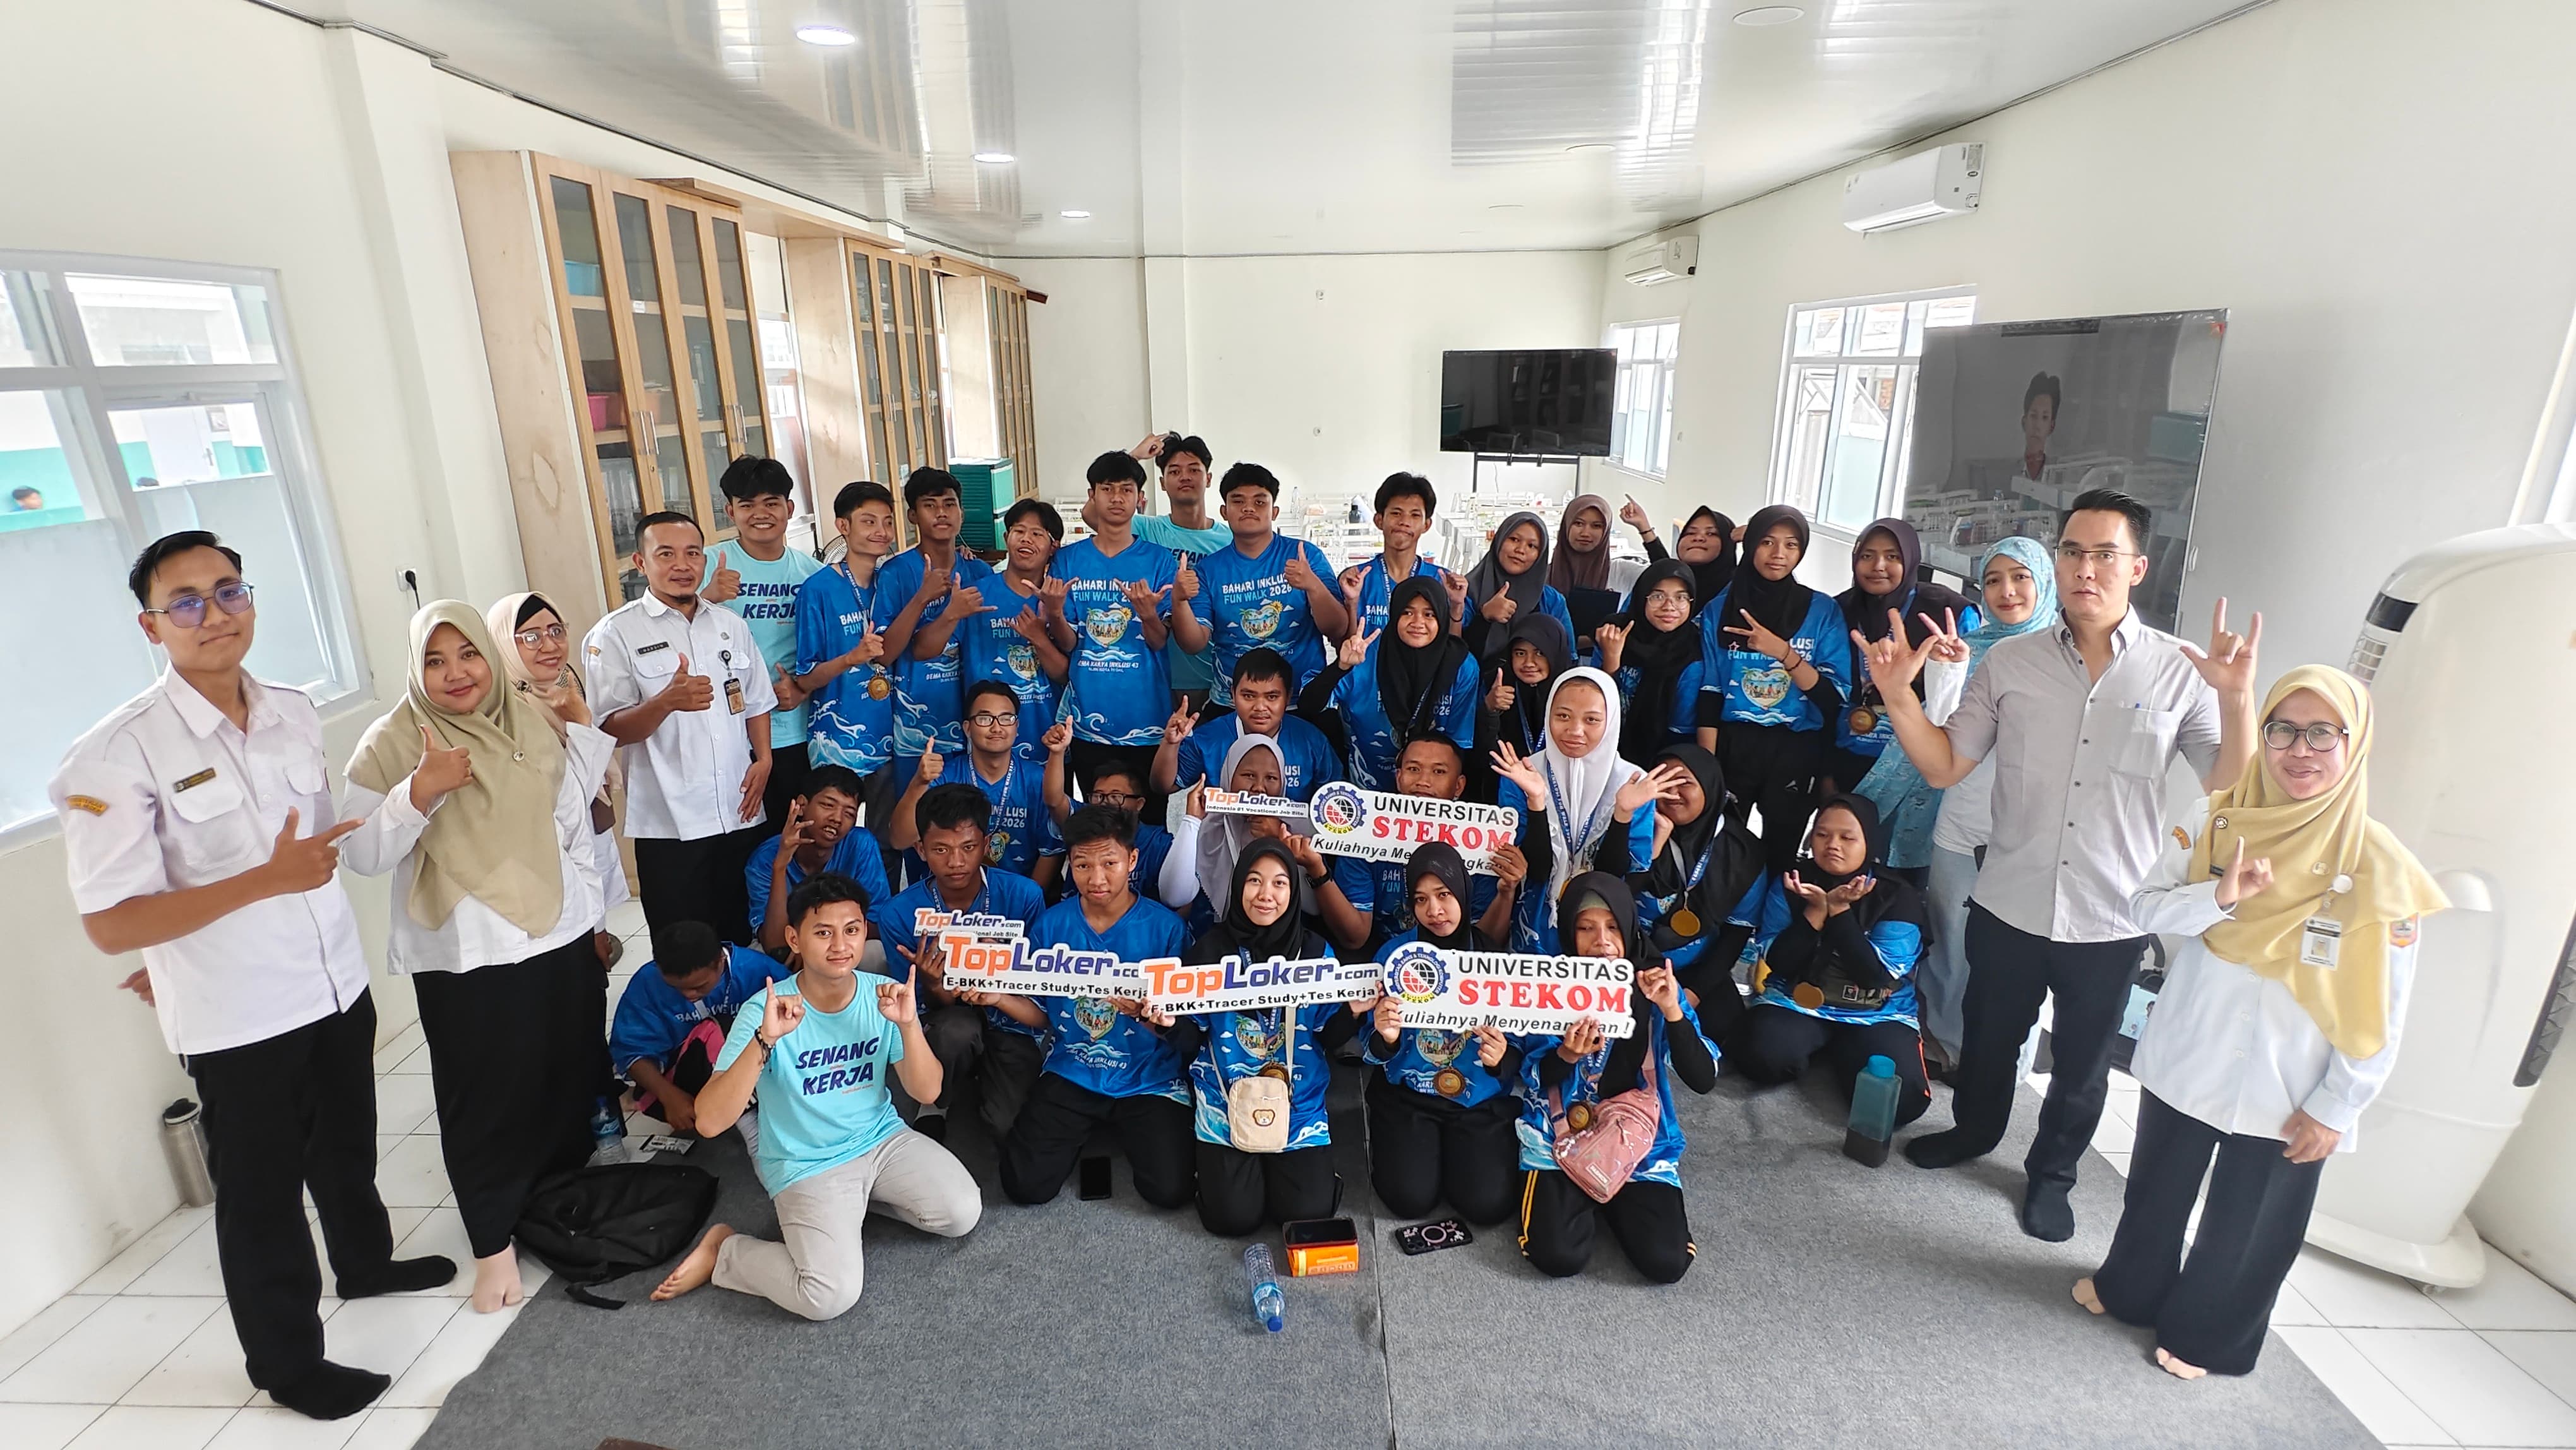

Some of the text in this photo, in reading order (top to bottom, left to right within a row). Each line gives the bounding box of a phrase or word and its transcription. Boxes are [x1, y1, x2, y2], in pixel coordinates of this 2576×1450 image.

[1071, 580, 1107, 591] BAHARI
[1222, 573, 1289, 594] BAHARI INKLUS
[1073, 591, 1090, 602] FUN
[1092, 591, 1119, 602] WALK
[1224, 584, 1292, 604] FUN WALK 2026
[1366, 604, 1388, 616] BAHA
[1366, 615, 1381, 625] FUN
[843, 622, 861, 637] FUN
[990, 617, 1018, 628] BAHA
[993, 628, 1010, 638] FUN
[1789, 637, 1815, 650] LUSI
[1728, 650, 1747, 660] FUN
[1287, 777, 1300, 787] 26
[1207, 789, 1307, 809] TopLoker.com
[991, 805, 1027, 818] INLUSI
[1374, 795, 1515, 827] UNIVERSITAS
[1002, 818, 1025, 828] 2026
[1372, 815, 1512, 852] STEKOM
[1314, 837, 1388, 858] Kuliahnya
[1383, 869, 1400, 881] BAH
[917, 910, 1022, 928] TopLoker.com
[945, 936, 1139, 978] TopLoker.co
[1458, 956, 1629, 981] UNIVERSITAS
[947, 977, 1148, 998] E-BKK+Tracer Study+Tes Kerja
[1144, 961, 1379, 998] TopLoker.com
[1152, 988, 1376, 1012] E-BKK+Tracer Study+Tes Kerja
[1458, 979, 1627, 1013] STEKOM
[1483, 1014, 1618, 1034] Menyenanan
[1624, 1021, 1630, 1034] !
[796, 1036, 880, 1069] SENANG
[803, 1062, 873, 1096] KERJA
